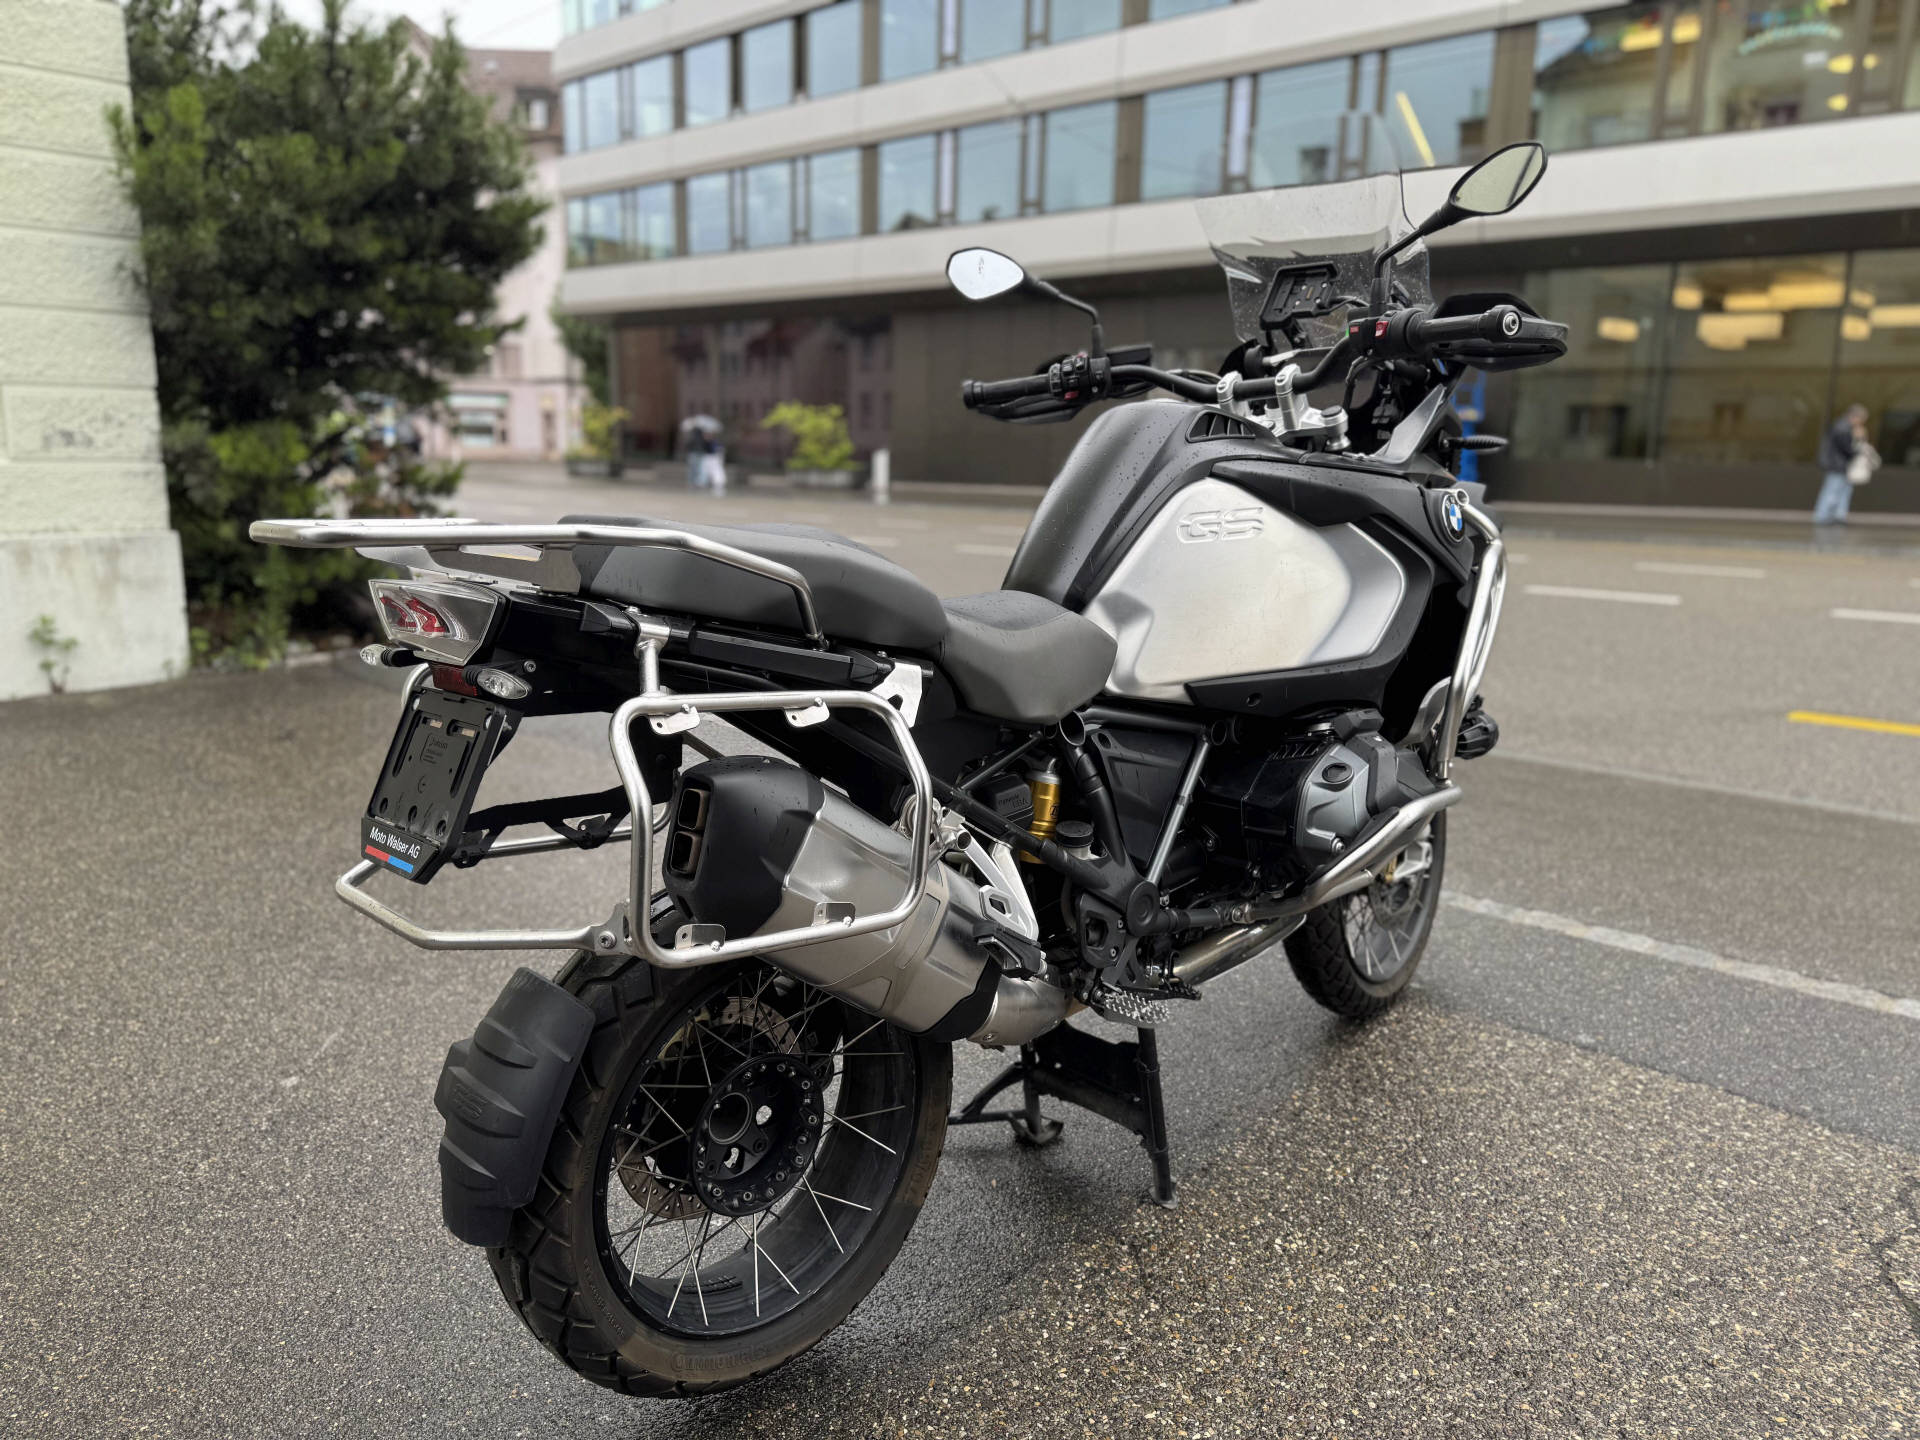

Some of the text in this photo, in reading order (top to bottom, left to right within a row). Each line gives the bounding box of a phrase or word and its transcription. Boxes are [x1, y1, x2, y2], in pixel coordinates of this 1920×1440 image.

[1176, 506, 1264, 544] GS
[369, 826, 387, 844] Moto
[407, 843, 421, 859] AG
